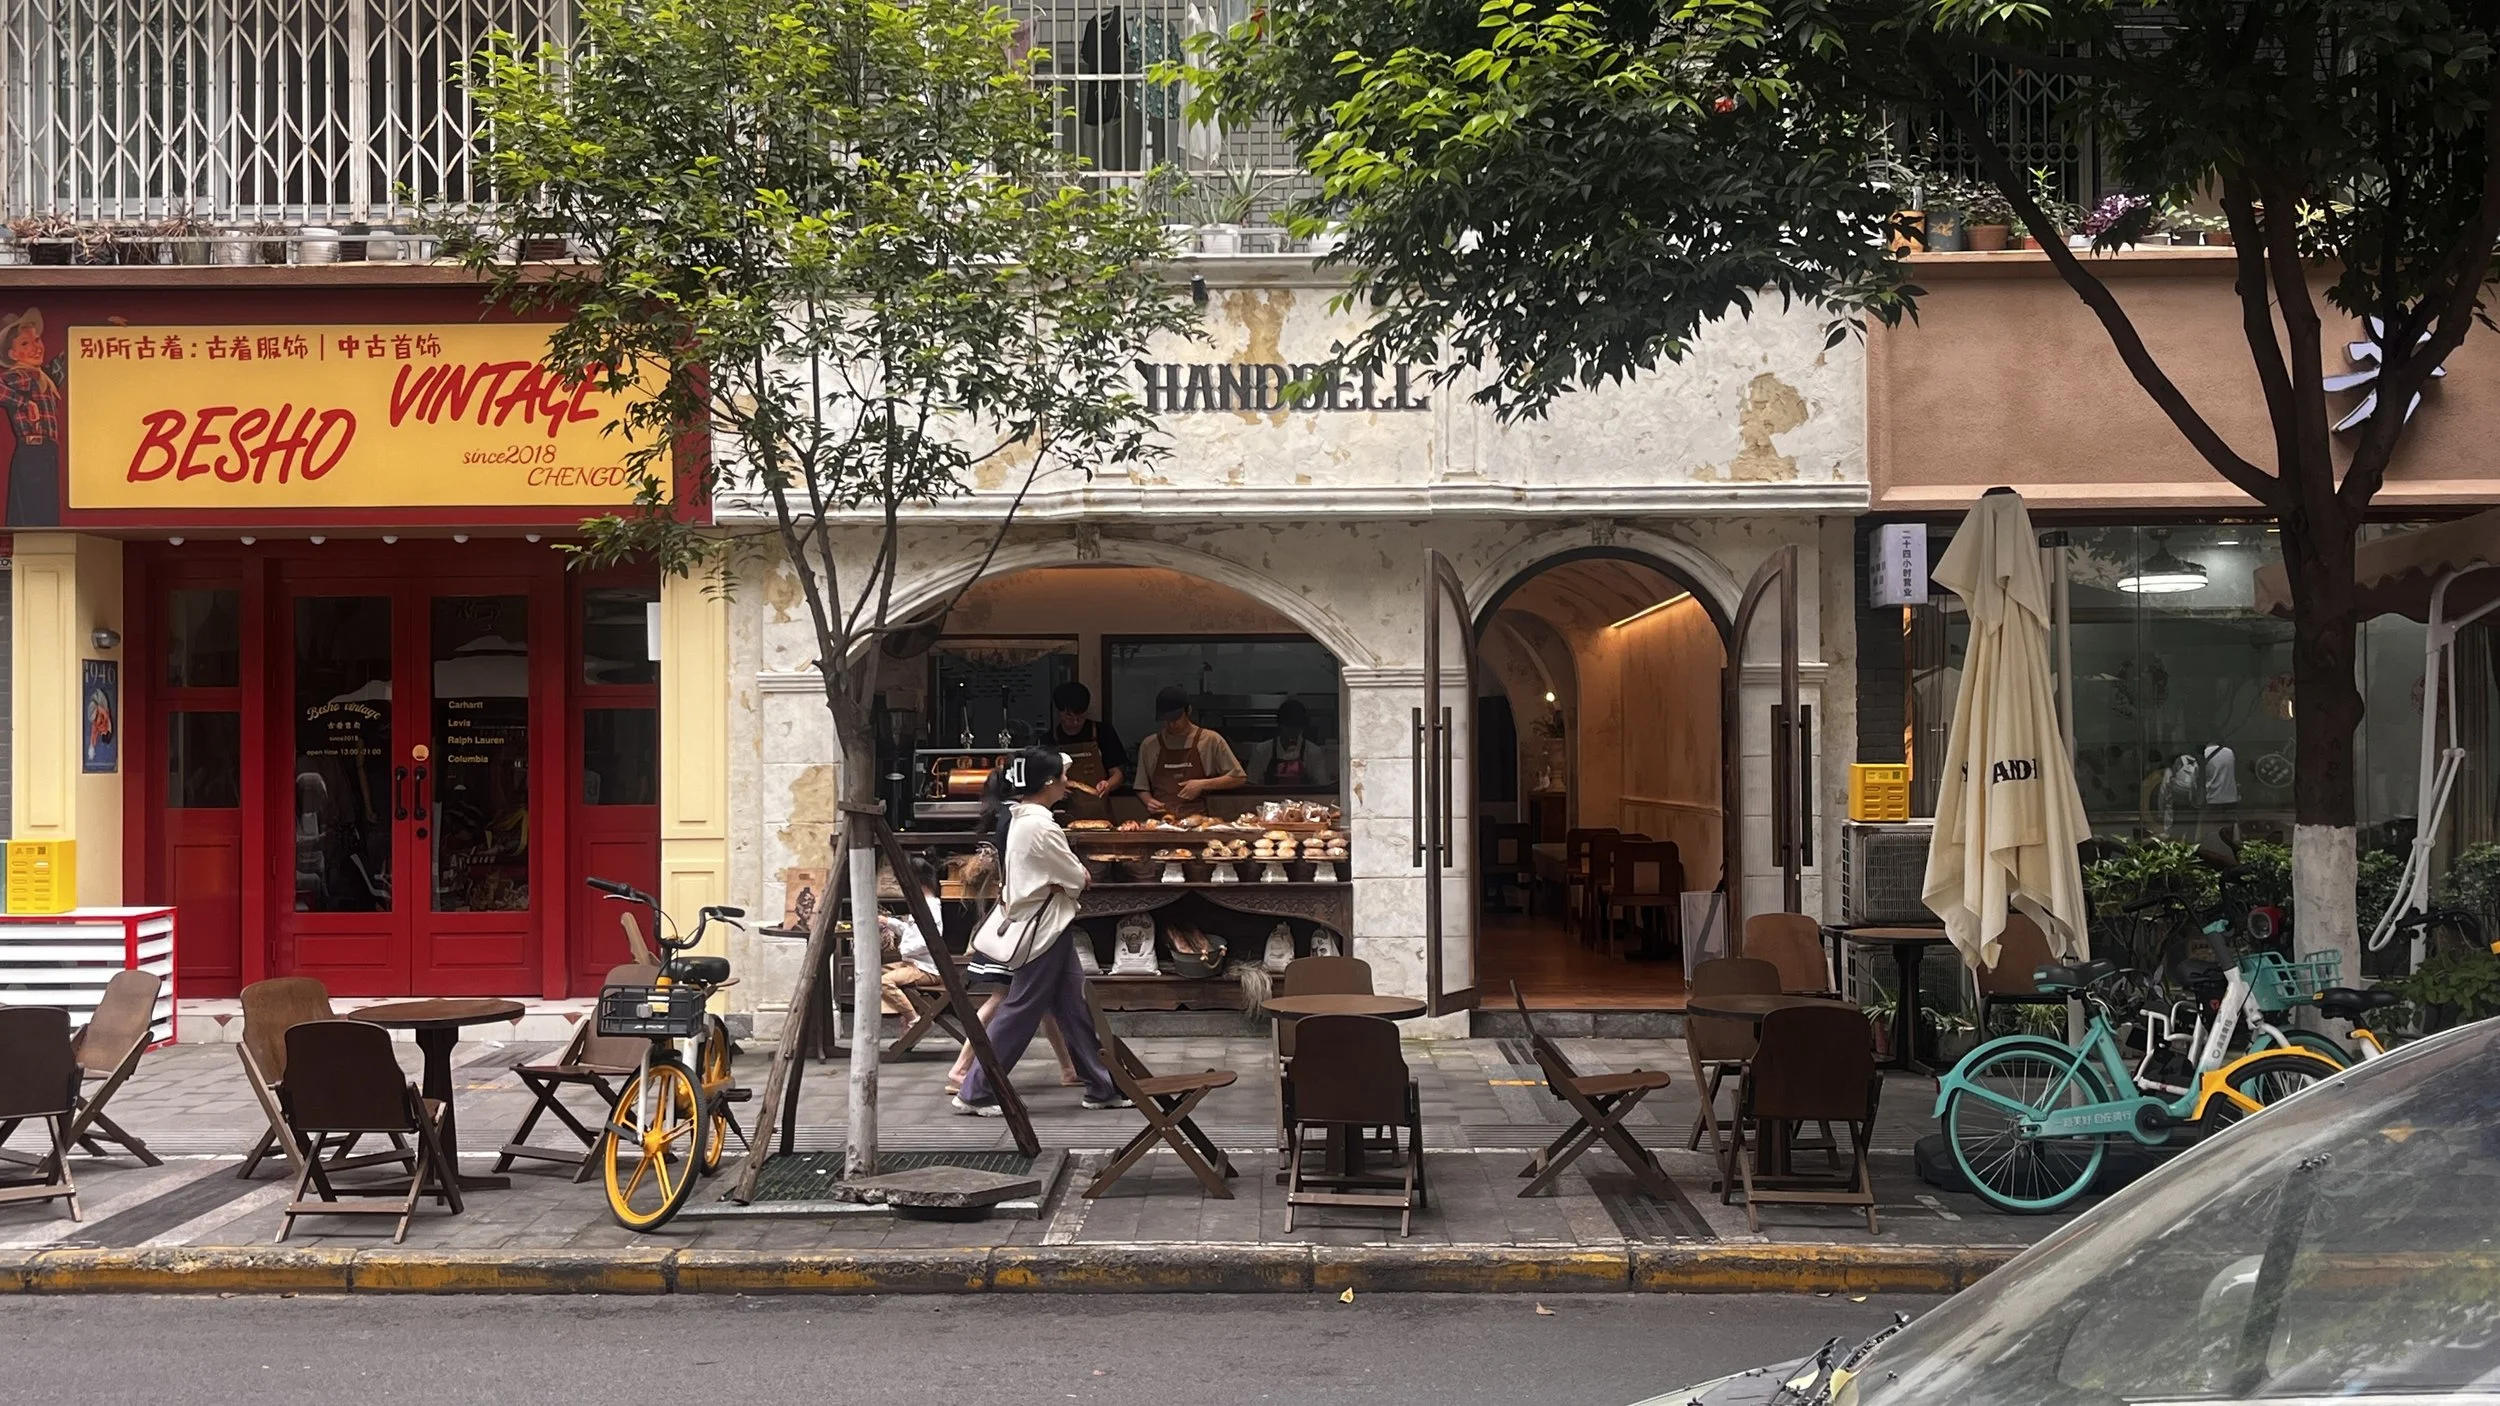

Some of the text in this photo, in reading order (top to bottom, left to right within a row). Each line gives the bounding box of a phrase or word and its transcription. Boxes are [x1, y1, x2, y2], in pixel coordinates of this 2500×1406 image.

[389, 361, 621, 438] VINTAGE
[127, 402, 357, 485] BESHO
[462, 444, 557, 465] since2018
[1902, 530, 1913, 597] 二十四小时营业
[448, 700, 484, 709] Carhartt
[447, 719, 471, 727] Levis
[447, 736, 505, 746] Ralph Lauren
[447, 754, 489, 763] Columbia
